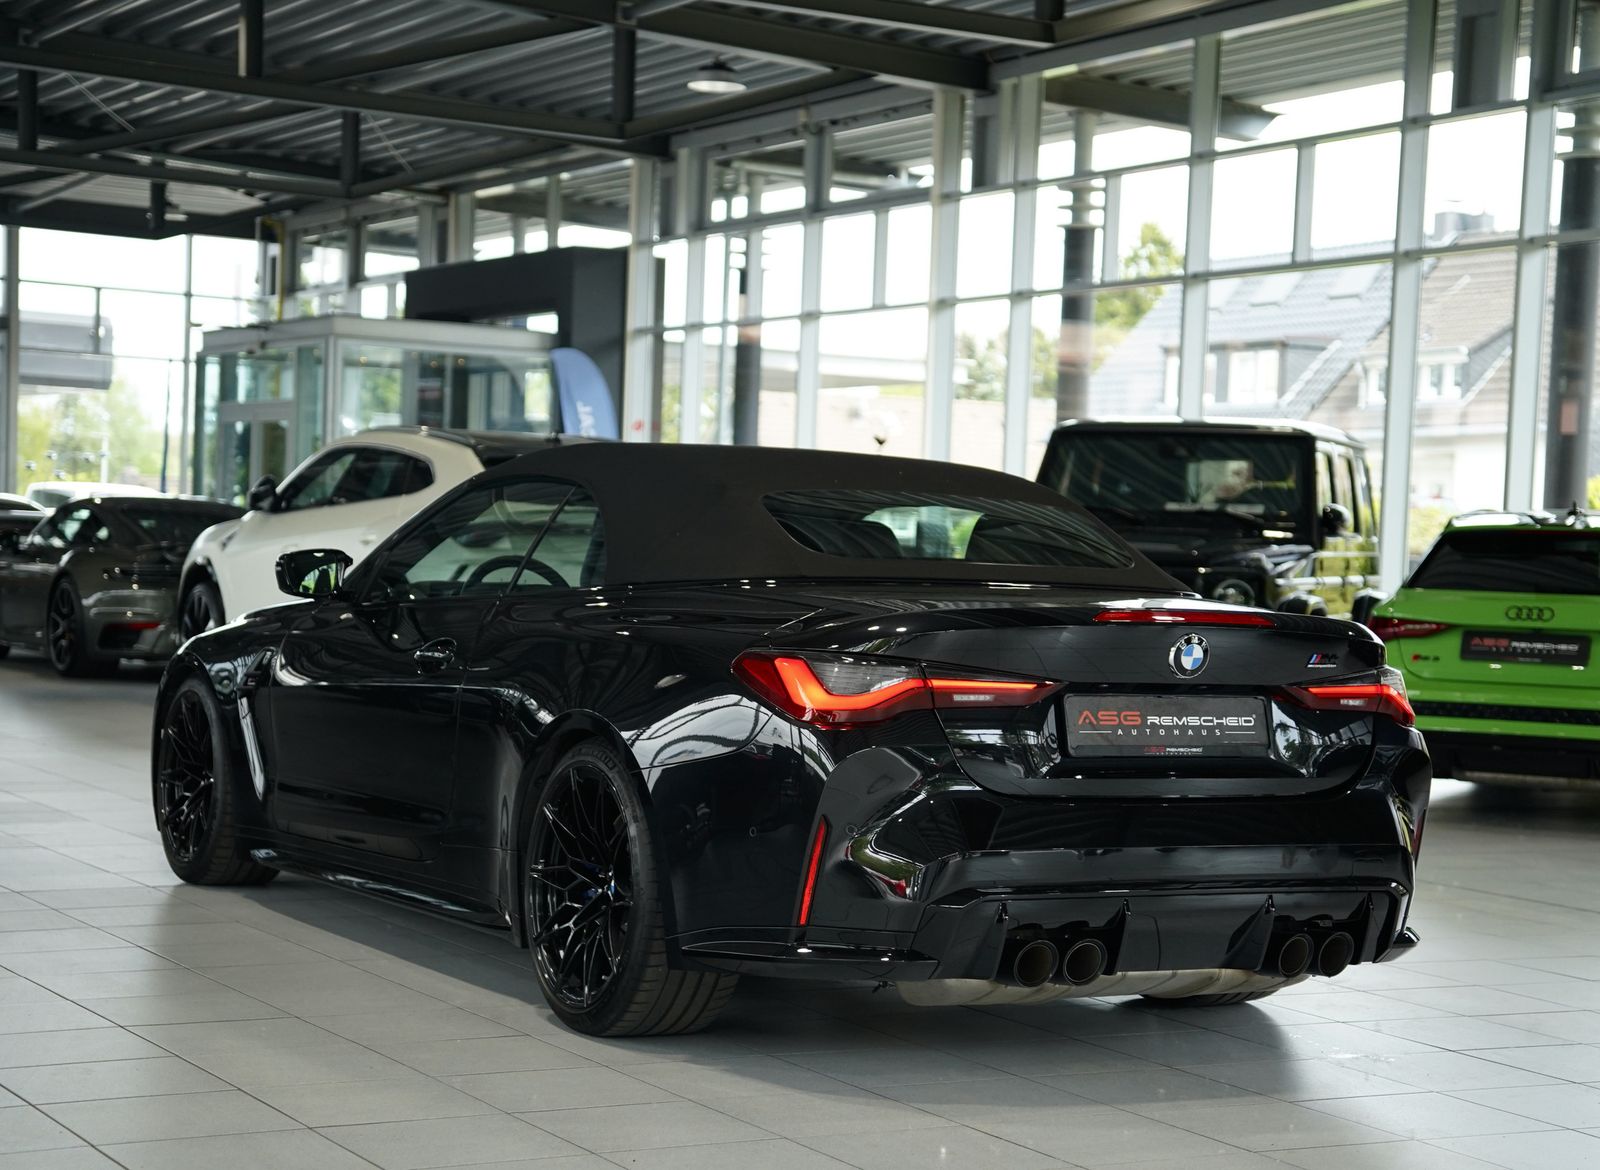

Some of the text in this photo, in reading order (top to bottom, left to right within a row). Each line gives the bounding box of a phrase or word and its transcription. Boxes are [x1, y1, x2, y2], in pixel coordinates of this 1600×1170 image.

[1179, 635, 1208, 650] BMW
[1078, 710, 1255, 727] ASG REMSCHEID
[1117, 728, 1221, 736] AUTOHAUS
